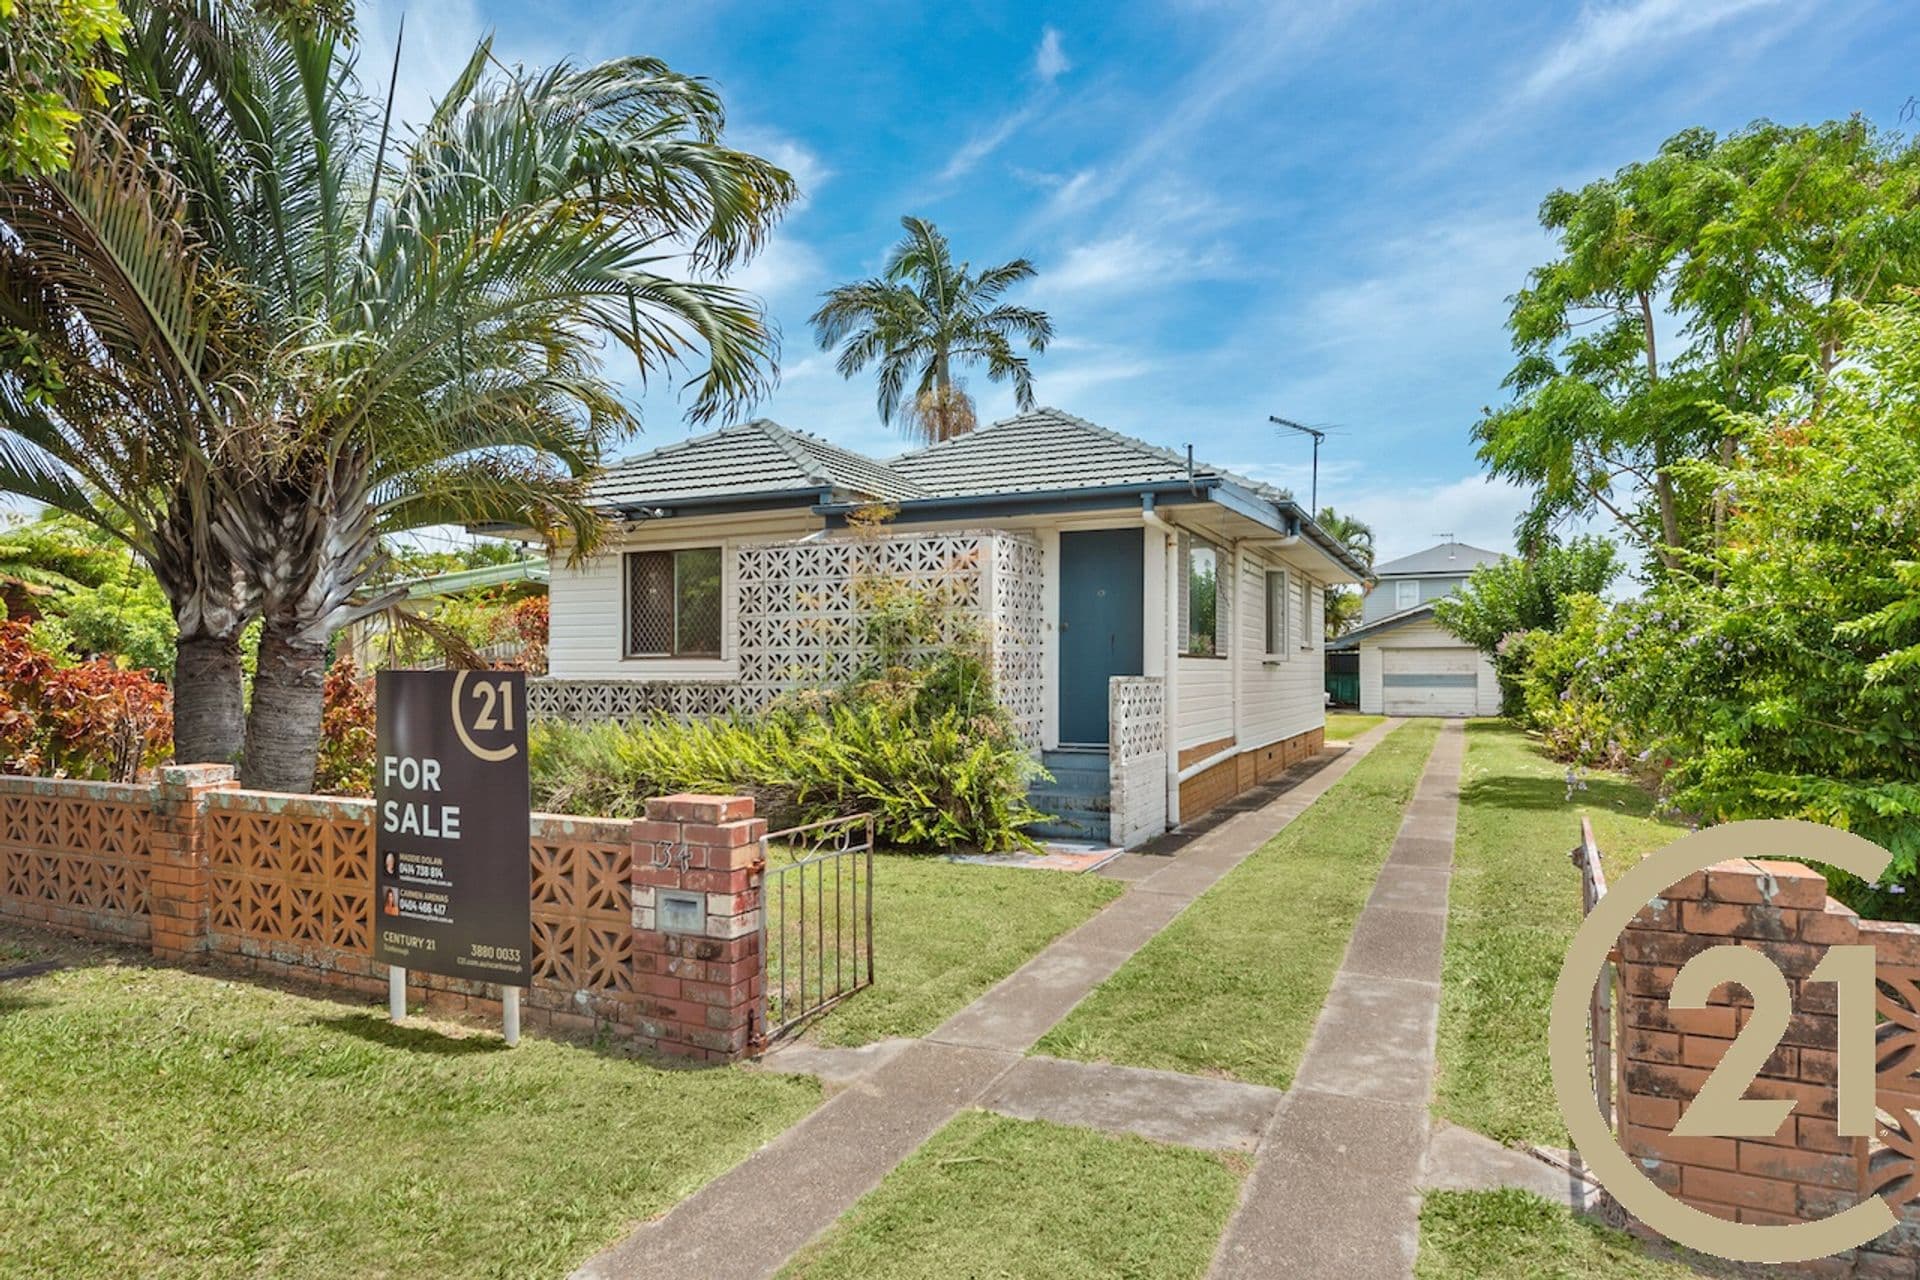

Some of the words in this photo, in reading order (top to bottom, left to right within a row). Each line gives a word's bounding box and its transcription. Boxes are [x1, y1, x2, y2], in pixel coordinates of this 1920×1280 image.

[472, 680, 514, 731] 21
[384, 756, 441, 792] FOR
[384, 800, 461, 840] SALE
[650, 841, 692, 873] 34
[383, 931, 425, 949] CENTURY
[426, 938, 436, 951] 21
[471, 943, 495, 959] 3880
[496, 947, 521, 962] 0033
